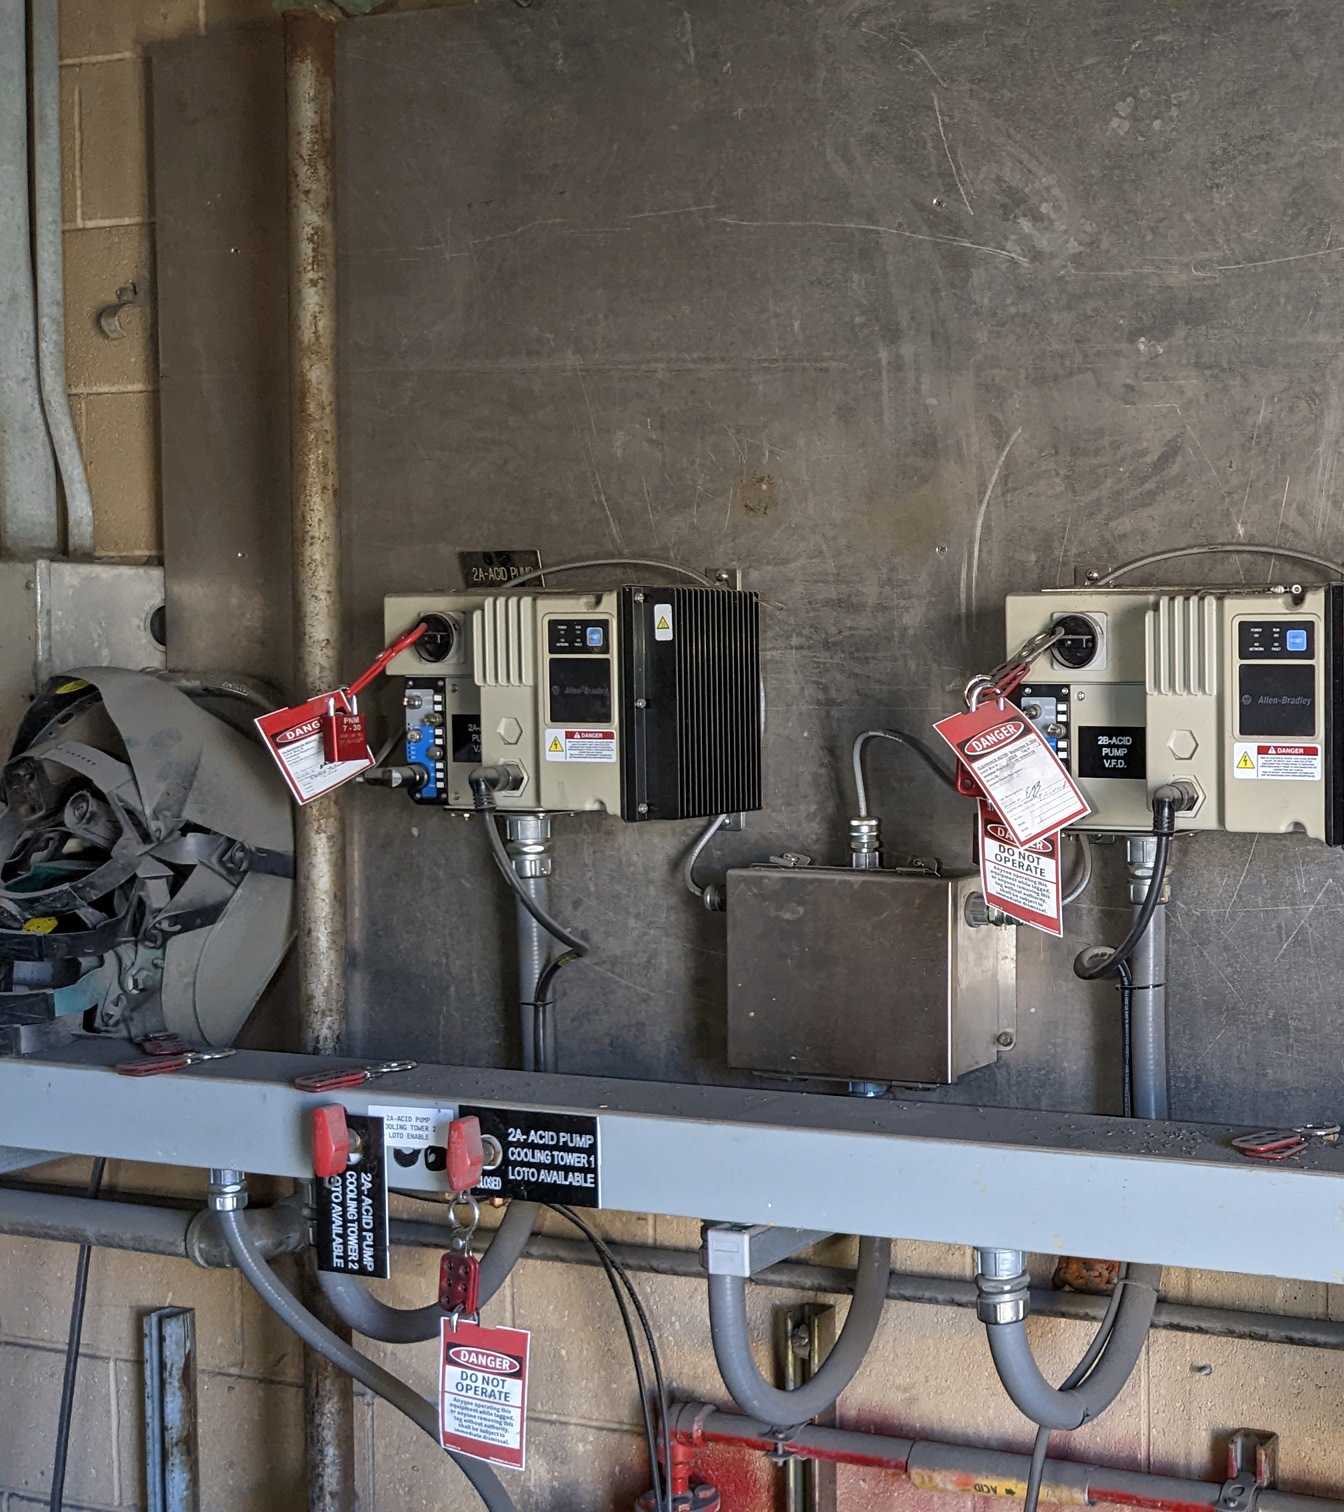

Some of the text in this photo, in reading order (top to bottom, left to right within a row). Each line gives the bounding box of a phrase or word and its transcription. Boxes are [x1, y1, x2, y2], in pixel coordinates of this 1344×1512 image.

[1258, 696, 1311, 705] Allen-Bradley
[286, 721, 320, 740] DANG
[972, 724, 1017, 752] DANGER
[1097, 736, 1132, 745] 2B-ACID
[1102, 748, 1127, 756] PUMP
[1104, 759, 1127, 768] V.F.D.
[995, 853, 1046, 877] OPERATE
[999, 844, 1041, 866] DO NOT
[508, 1128, 594, 1148] 2A- ACID PUMP
[508, 1147, 595, 1168] COOLING TOWER 1
[477, 1176, 502, 1190] LOSED
[508, 1166, 595, 1188] LOTO AVAILABLE
[331, 1175, 344, 1268] OTO AVAILABLE
[346, 1171, 359, 1270] COOLING TOWER 2
[361, 1172, 374, 1272] 2A- ACID PUMP
[460, 1350, 509, 1370] DANGER
[461, 1371, 506, 1389] DO NOT
[456, 1382, 510, 1402] OPERATE
